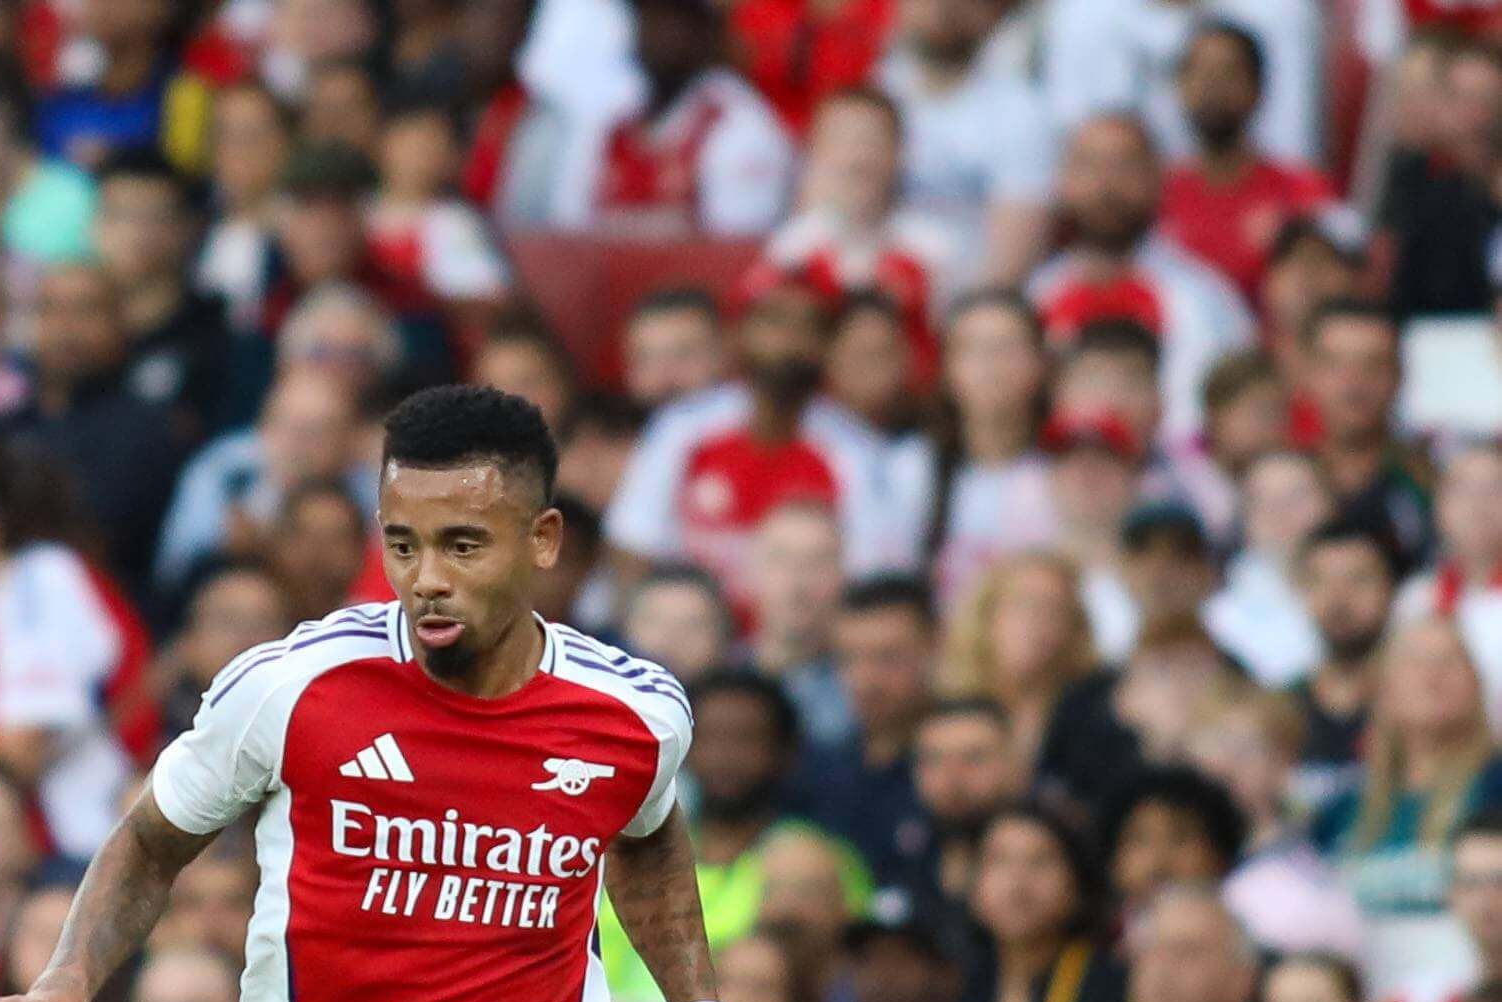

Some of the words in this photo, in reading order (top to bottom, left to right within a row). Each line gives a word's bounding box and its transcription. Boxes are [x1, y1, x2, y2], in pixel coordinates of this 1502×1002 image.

[330, 799, 600, 878] Emirates
[361, 868, 428, 917] FLY
[434, 875, 560, 928] BETTER
